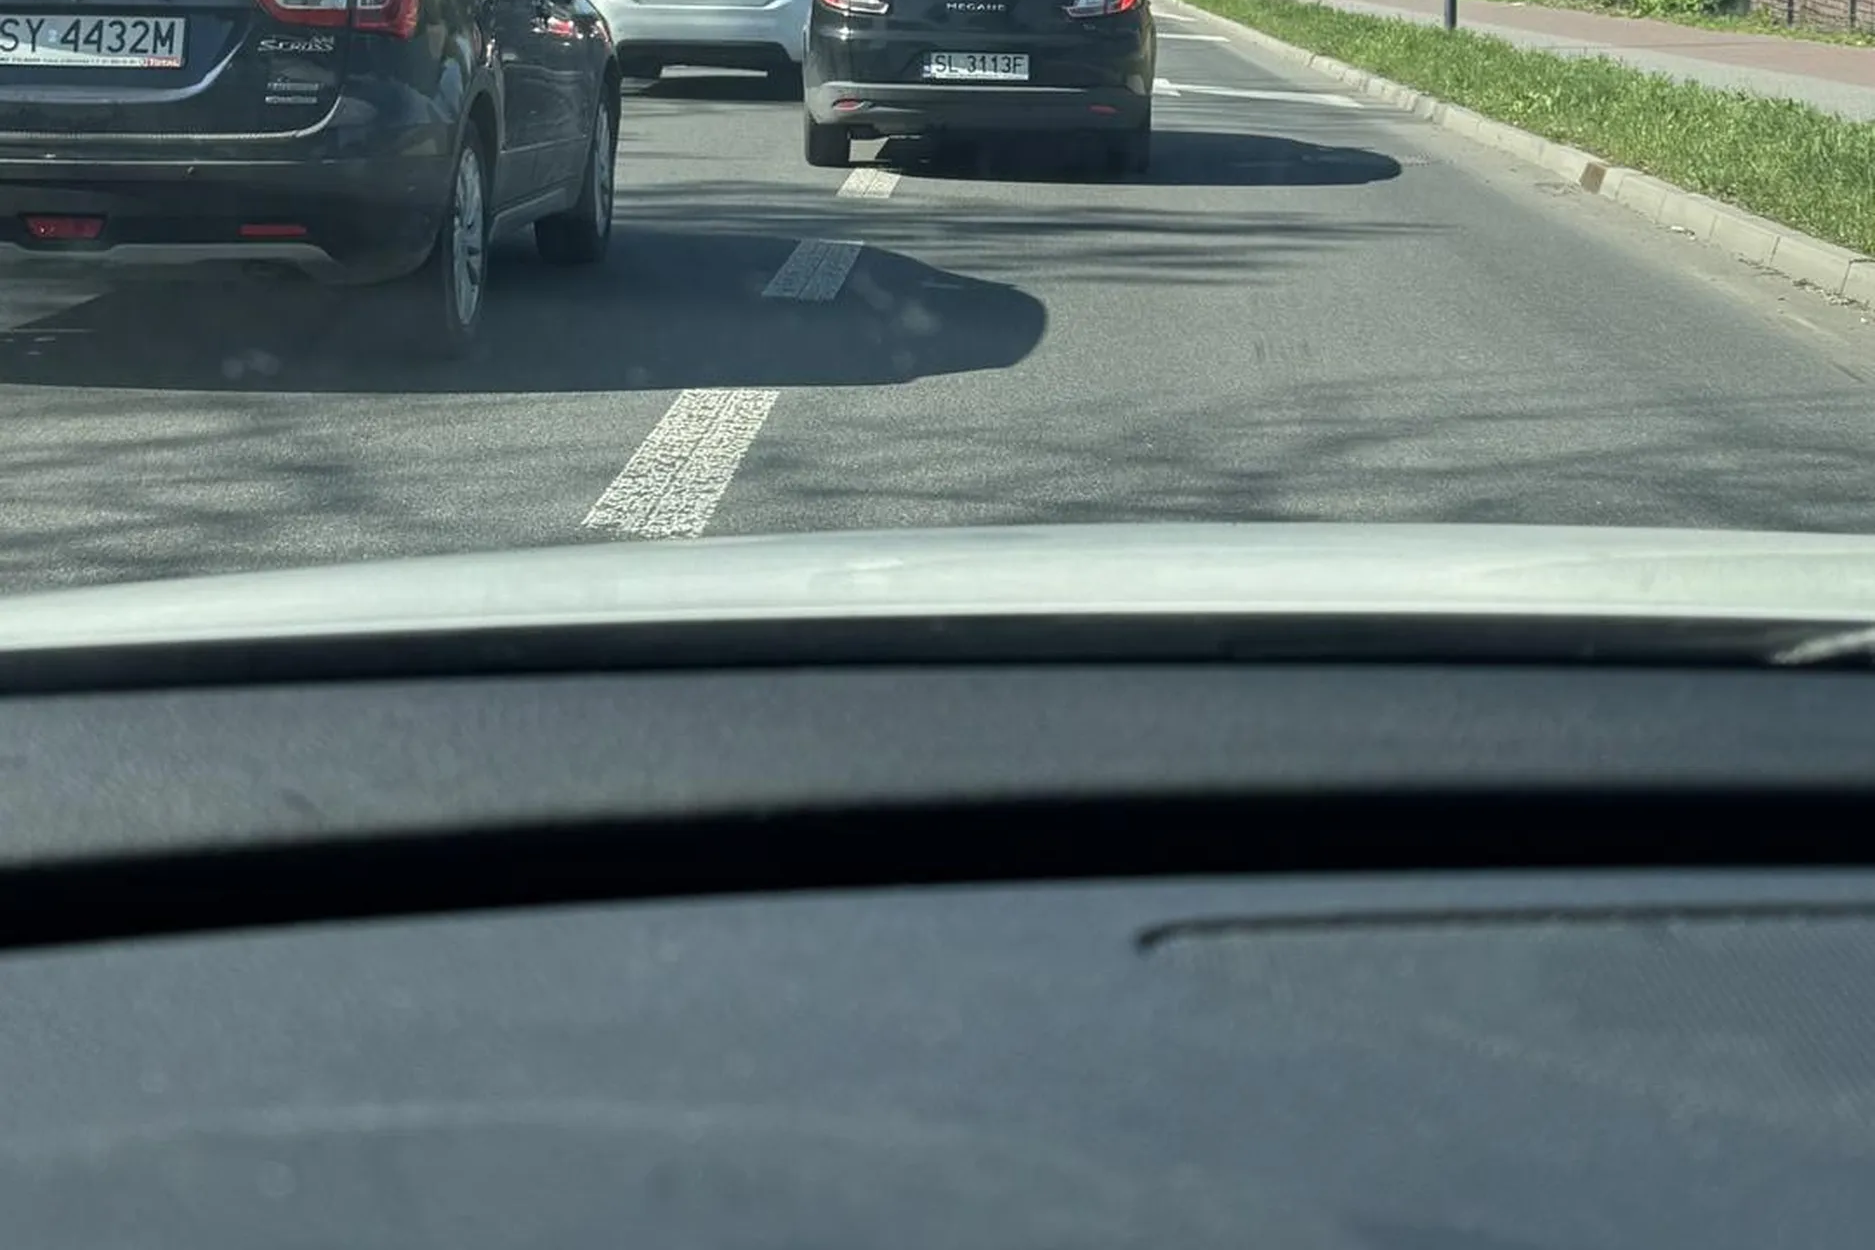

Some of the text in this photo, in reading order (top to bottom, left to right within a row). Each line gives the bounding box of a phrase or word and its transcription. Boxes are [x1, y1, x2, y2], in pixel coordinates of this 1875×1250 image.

[0, 18, 175, 55] SY 4432M
[934, 55, 1025, 74] SL 3113F
